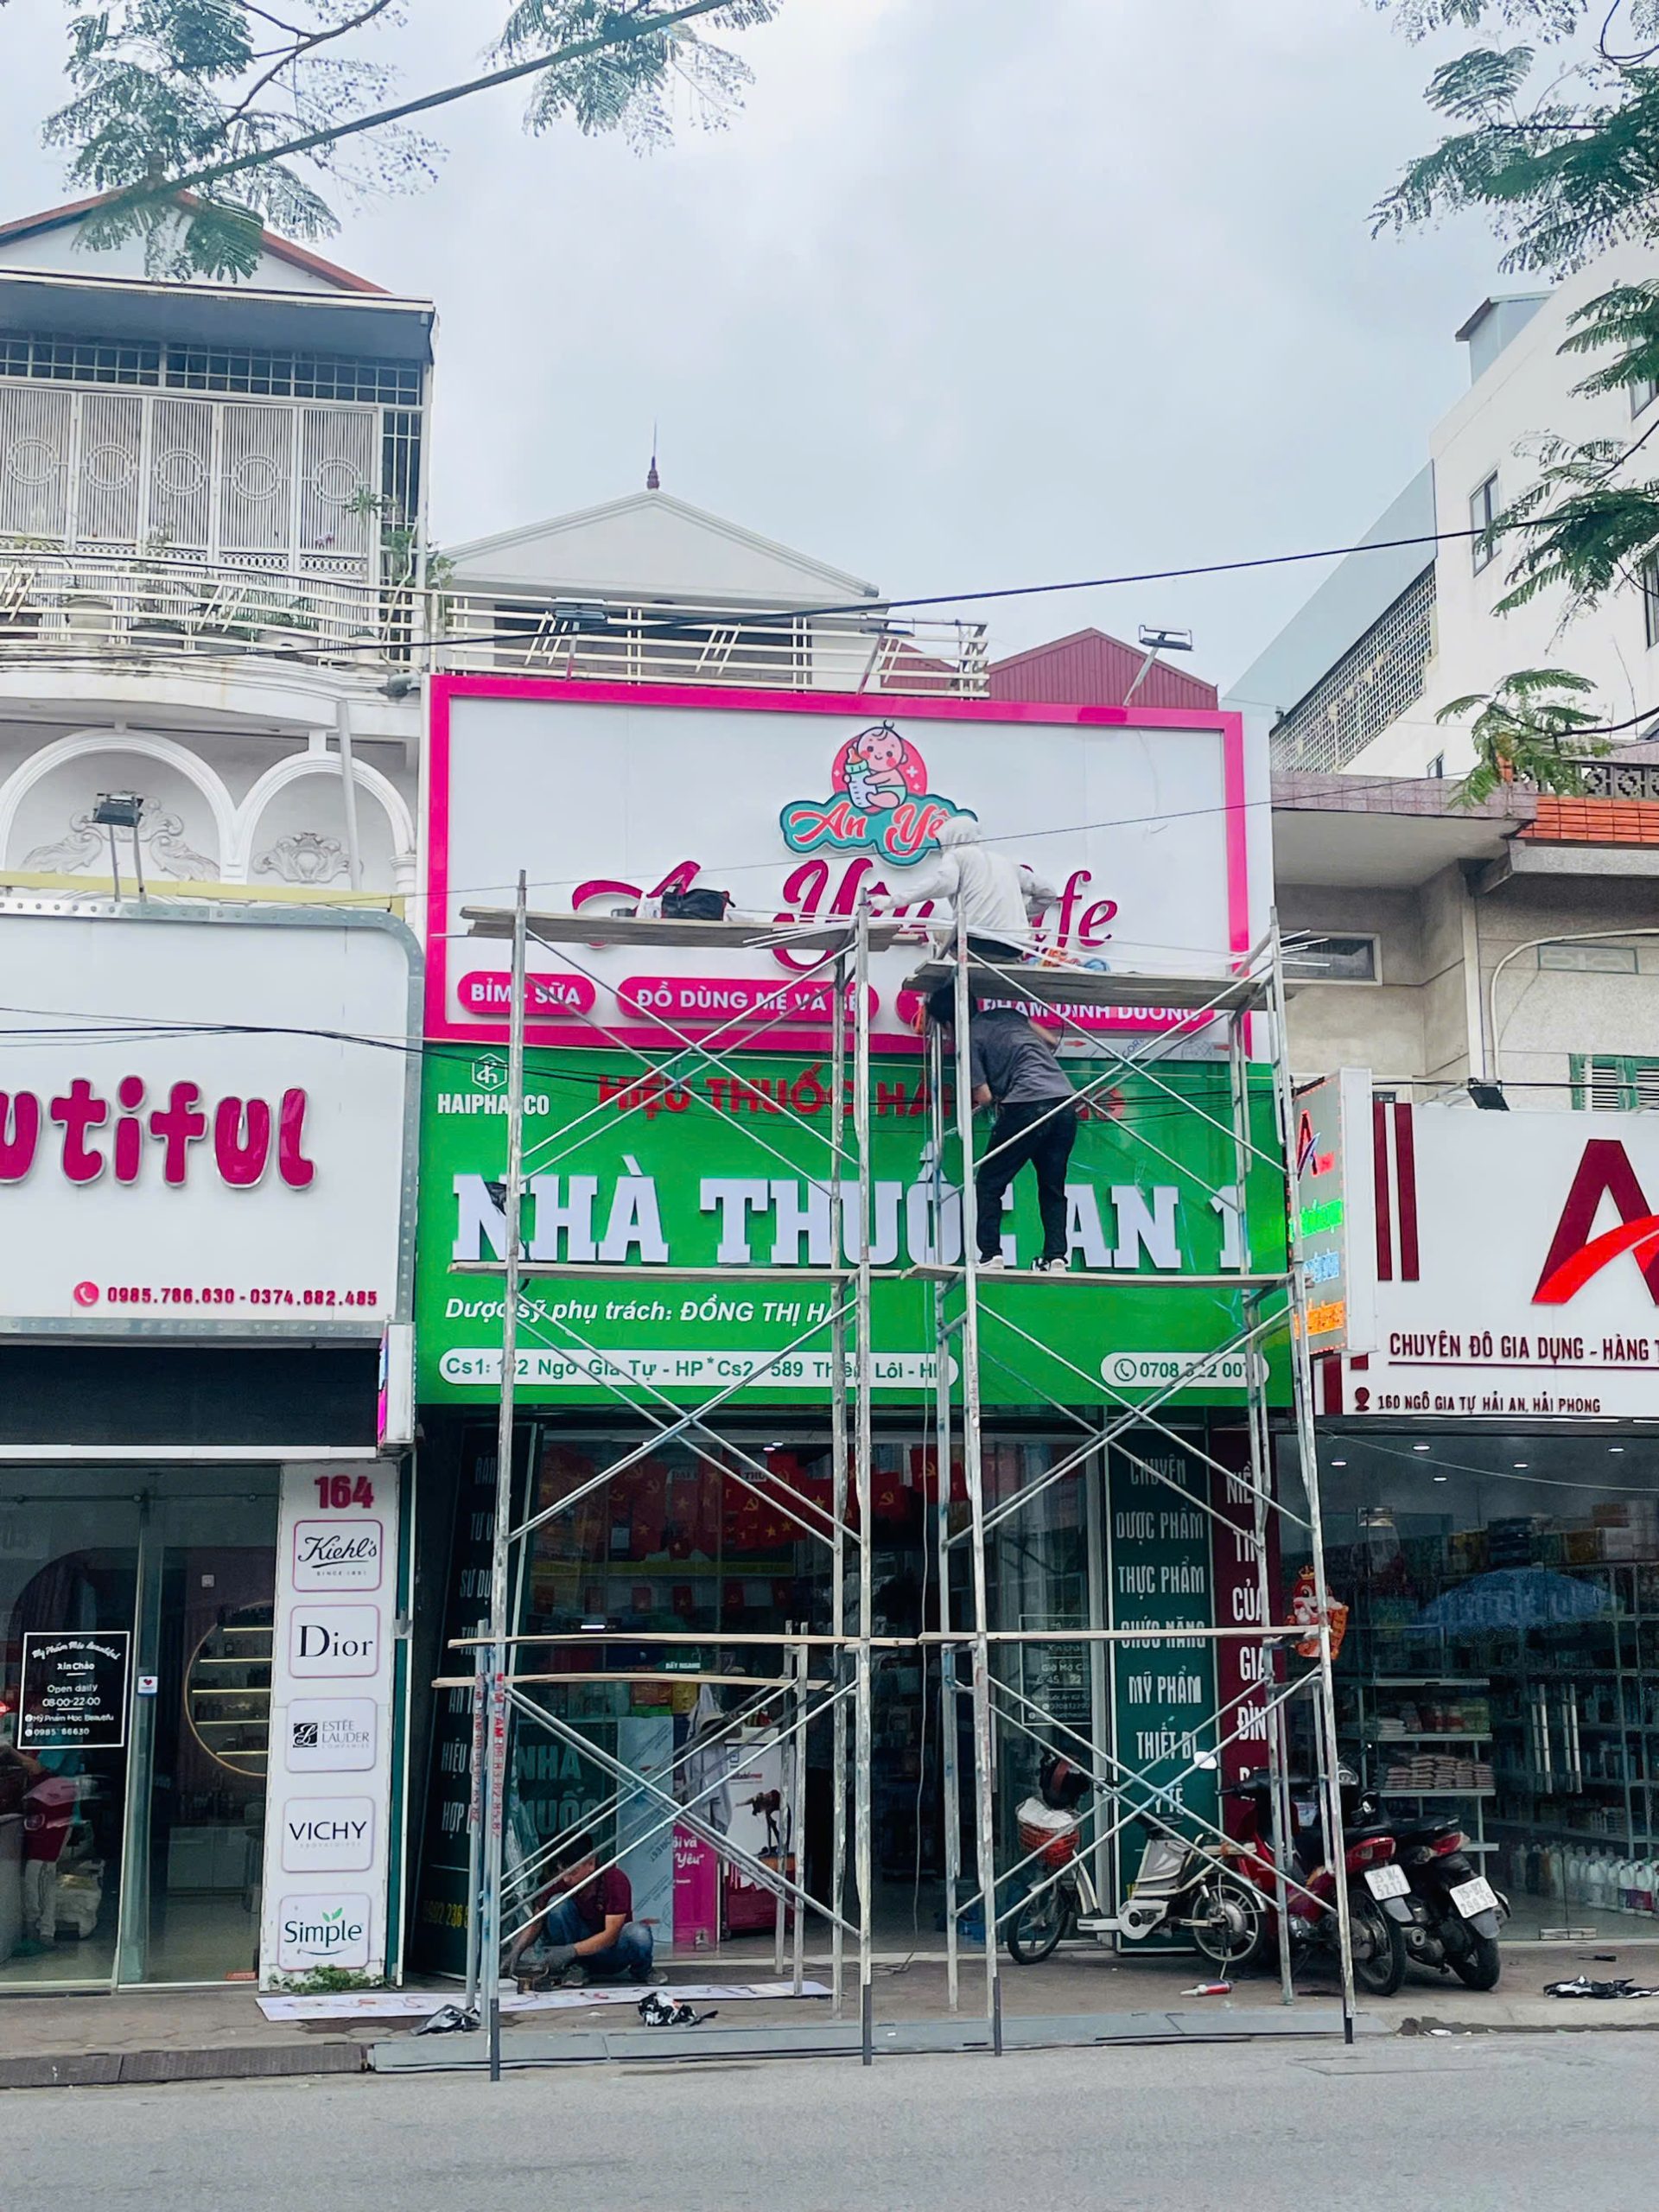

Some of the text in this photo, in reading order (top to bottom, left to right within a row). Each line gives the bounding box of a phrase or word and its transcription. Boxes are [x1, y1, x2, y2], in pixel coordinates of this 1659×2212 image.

[790, 801, 951, 856] An Yê
[637, 981, 673, 1007] ĐỒ
[680, 986, 748, 1009] DÙNG
[795, 988, 827, 1011] VÀ
[437, 1093, 550, 1116] HAIPHACO
[452, 1154, 669, 1263] NHÀ
[1063, 1183, 1182, 1269] AN
[550, 1300, 598, 1325] phụ
[605, 1300, 671, 1323] trách:
[680, 1296, 754, 1322] ĐỒNG
[762, 1302, 801, 1326] THỊ
[1389, 1330, 1461, 1357] CHUYÊN
[1501, 1336, 1530, 1359] GIA
[1538, 1337, 1584, 1364] DỤNG
[1603, 1333, 1649, 1362] HÀNG
[1140, 1362, 1179, 1378] 0708
[1378, 1395, 1401, 1410] 160
[1404, 1390, 1430, 1410] NGÔ
[1435, 1395, 1455, 1411] GIA
[1482, 1390, 1504, 1412] HẢI
[1509, 1397, 1529, 1414] AN,
[1533, 1390, 1554, 1413] HẢI
[315, 1475, 375, 1510] 164
[1226, 1459, 1254, 1504] NIỀ
[1116, 1502, 1205, 1546] DƯỢC PHẨM
[297, 1535, 378, 1562] Kiehl's
[1118, 1555, 1205, 1600] THỰC PHẨM
[296, 1624, 374, 1658] Dior
[47, 1683, 99, 1694] Open daily
[1128, 1664, 1203, 1705] MỸ PHẨM
[1236, 1700, 1270, 1741] ĐÌN
[321, 1732, 370, 1744] LAUDER
[289, 1820, 367, 1841] VICHY
[283, 1920, 363, 1948] Simple
